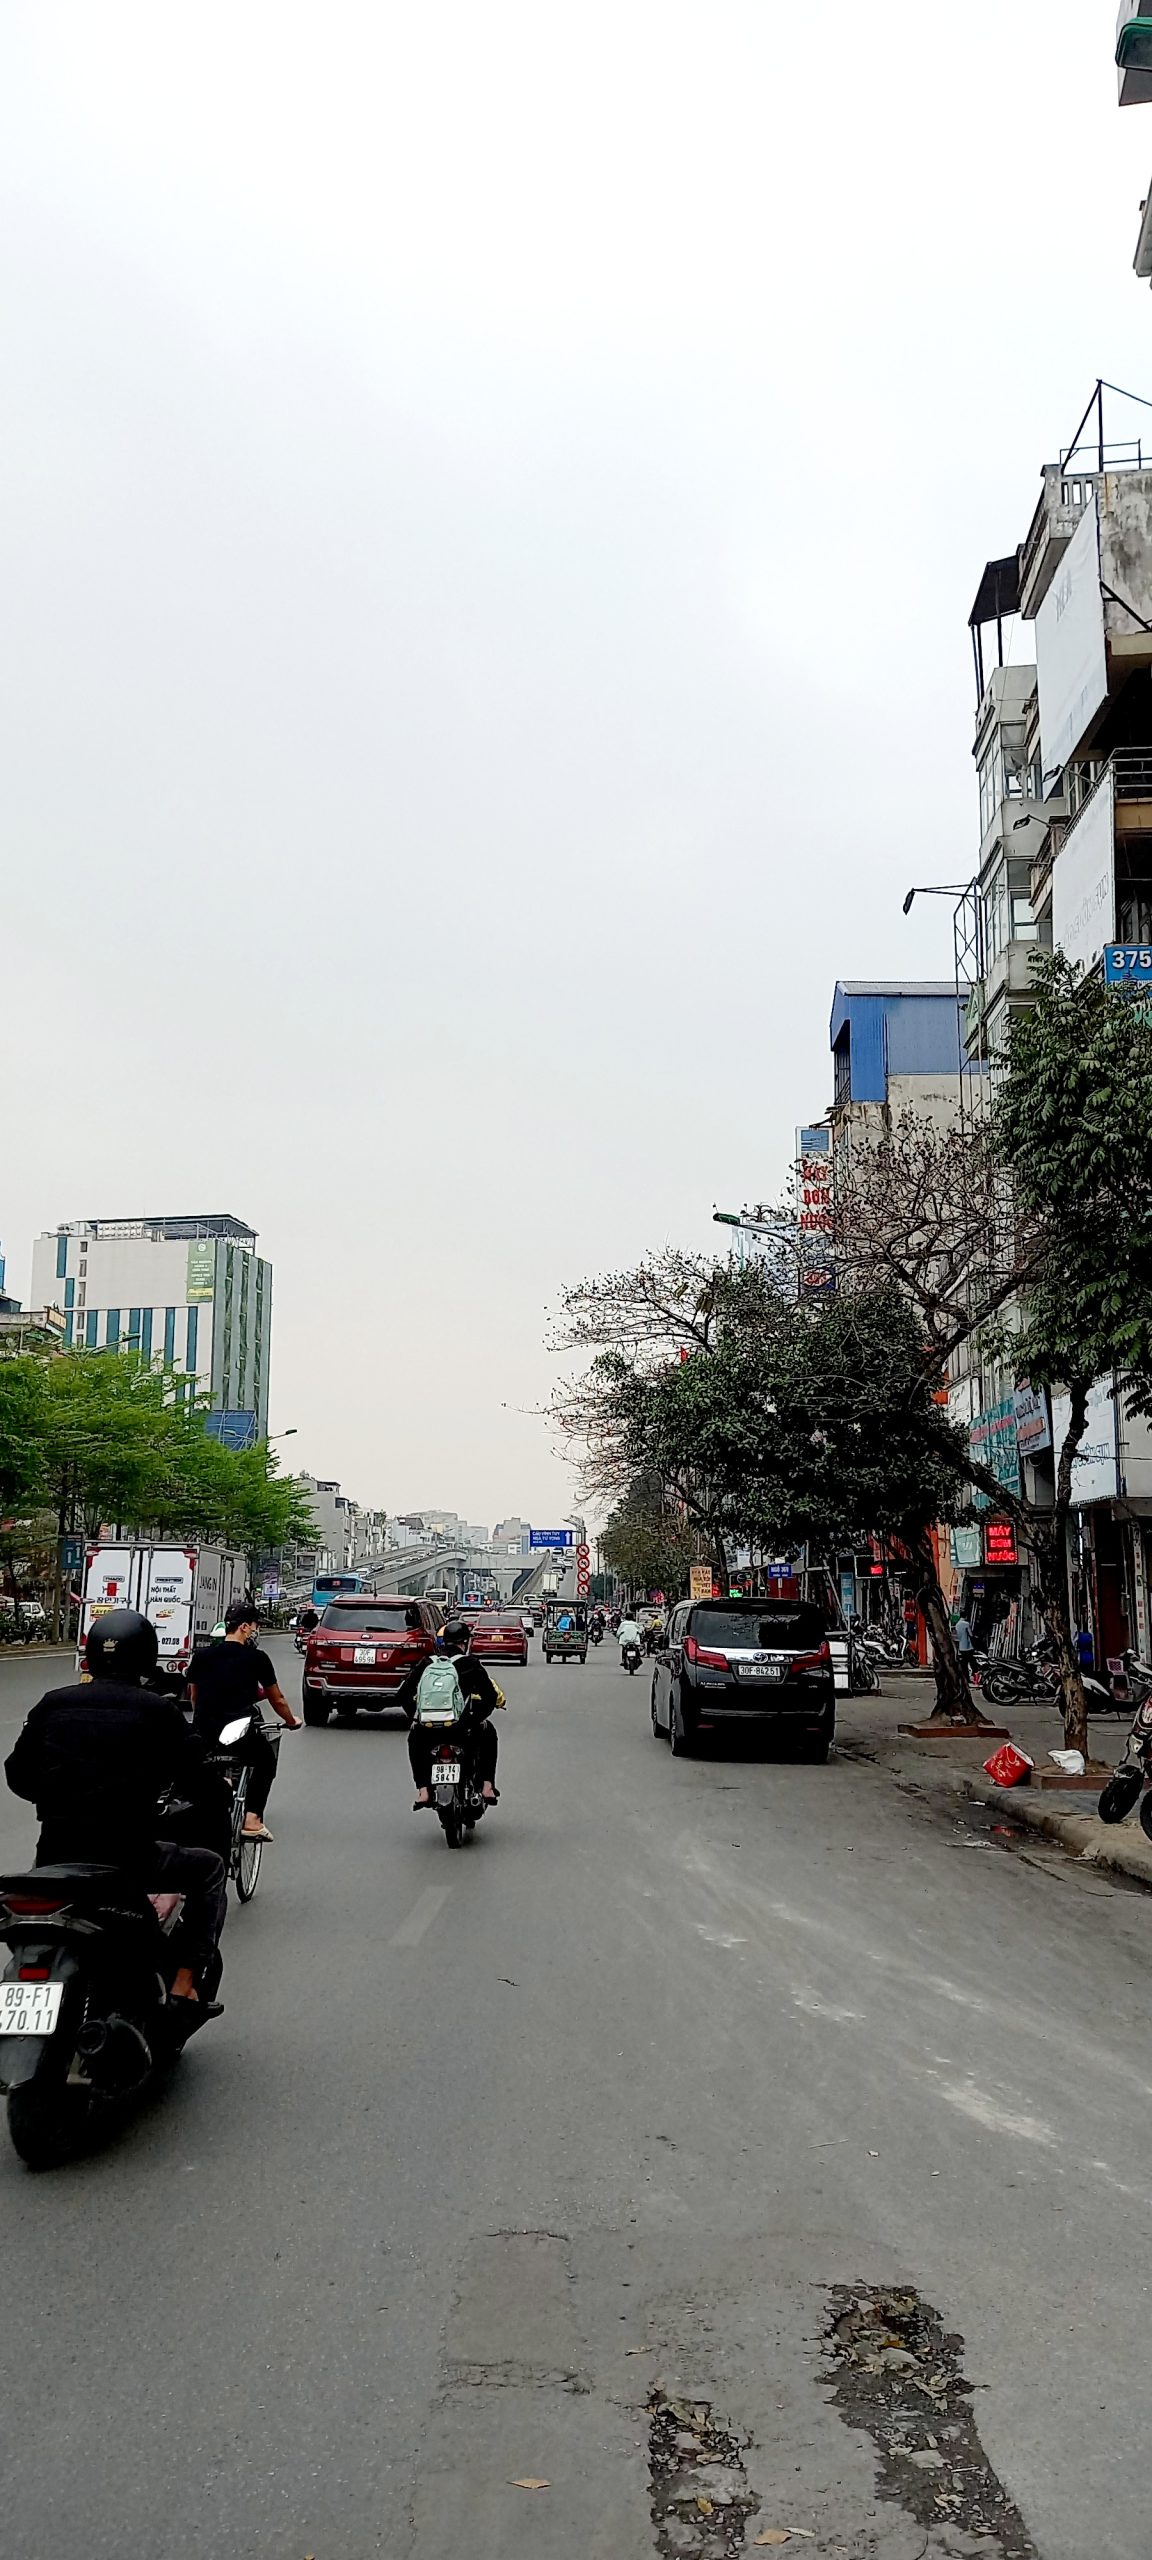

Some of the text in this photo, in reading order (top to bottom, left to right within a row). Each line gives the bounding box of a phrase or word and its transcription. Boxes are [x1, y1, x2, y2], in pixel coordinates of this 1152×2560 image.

[1111, 950, 1152, 969] 375
[988, 1524, 1012, 1537] MÁY
[435, 1773, 456, 1782] 5841
[5, 1986, 52, 2007] 89-F1
[0, 2009, 53, 2031] 70.11
